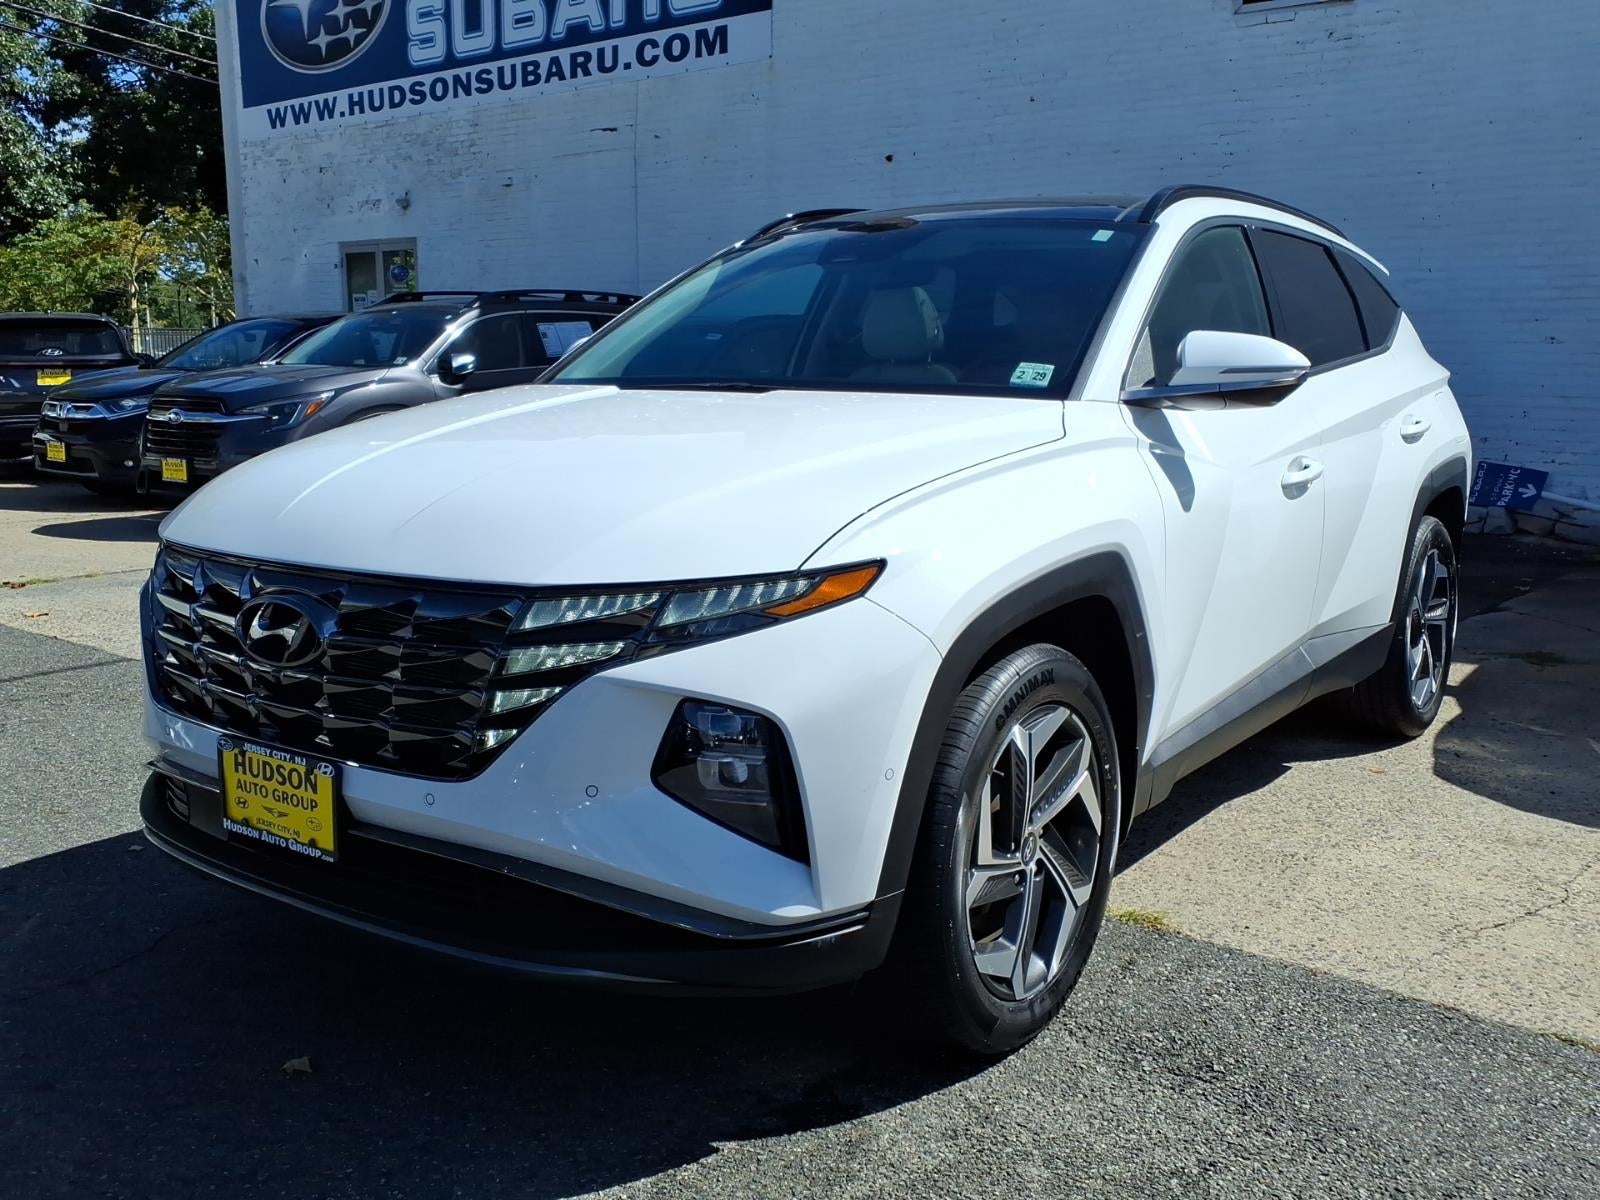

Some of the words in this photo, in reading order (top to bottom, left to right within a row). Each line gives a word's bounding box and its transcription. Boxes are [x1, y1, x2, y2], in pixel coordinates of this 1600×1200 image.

[267, 25, 729, 129] WWW.HUDSONSUBARU.COM
[1016, 371, 1025, 379] 2
[1032, 371, 1047, 381] 29
[1496, 468, 1521, 506] PARKING
[243, 742, 270, 756] JERSEY
[294, 754, 307, 766] NJ
[234, 752, 318, 794] HUDSON
[236, 778, 268, 798] AUTO
[272, 790, 319, 812] GROUP
[256, 817, 276, 829] JERSEY
